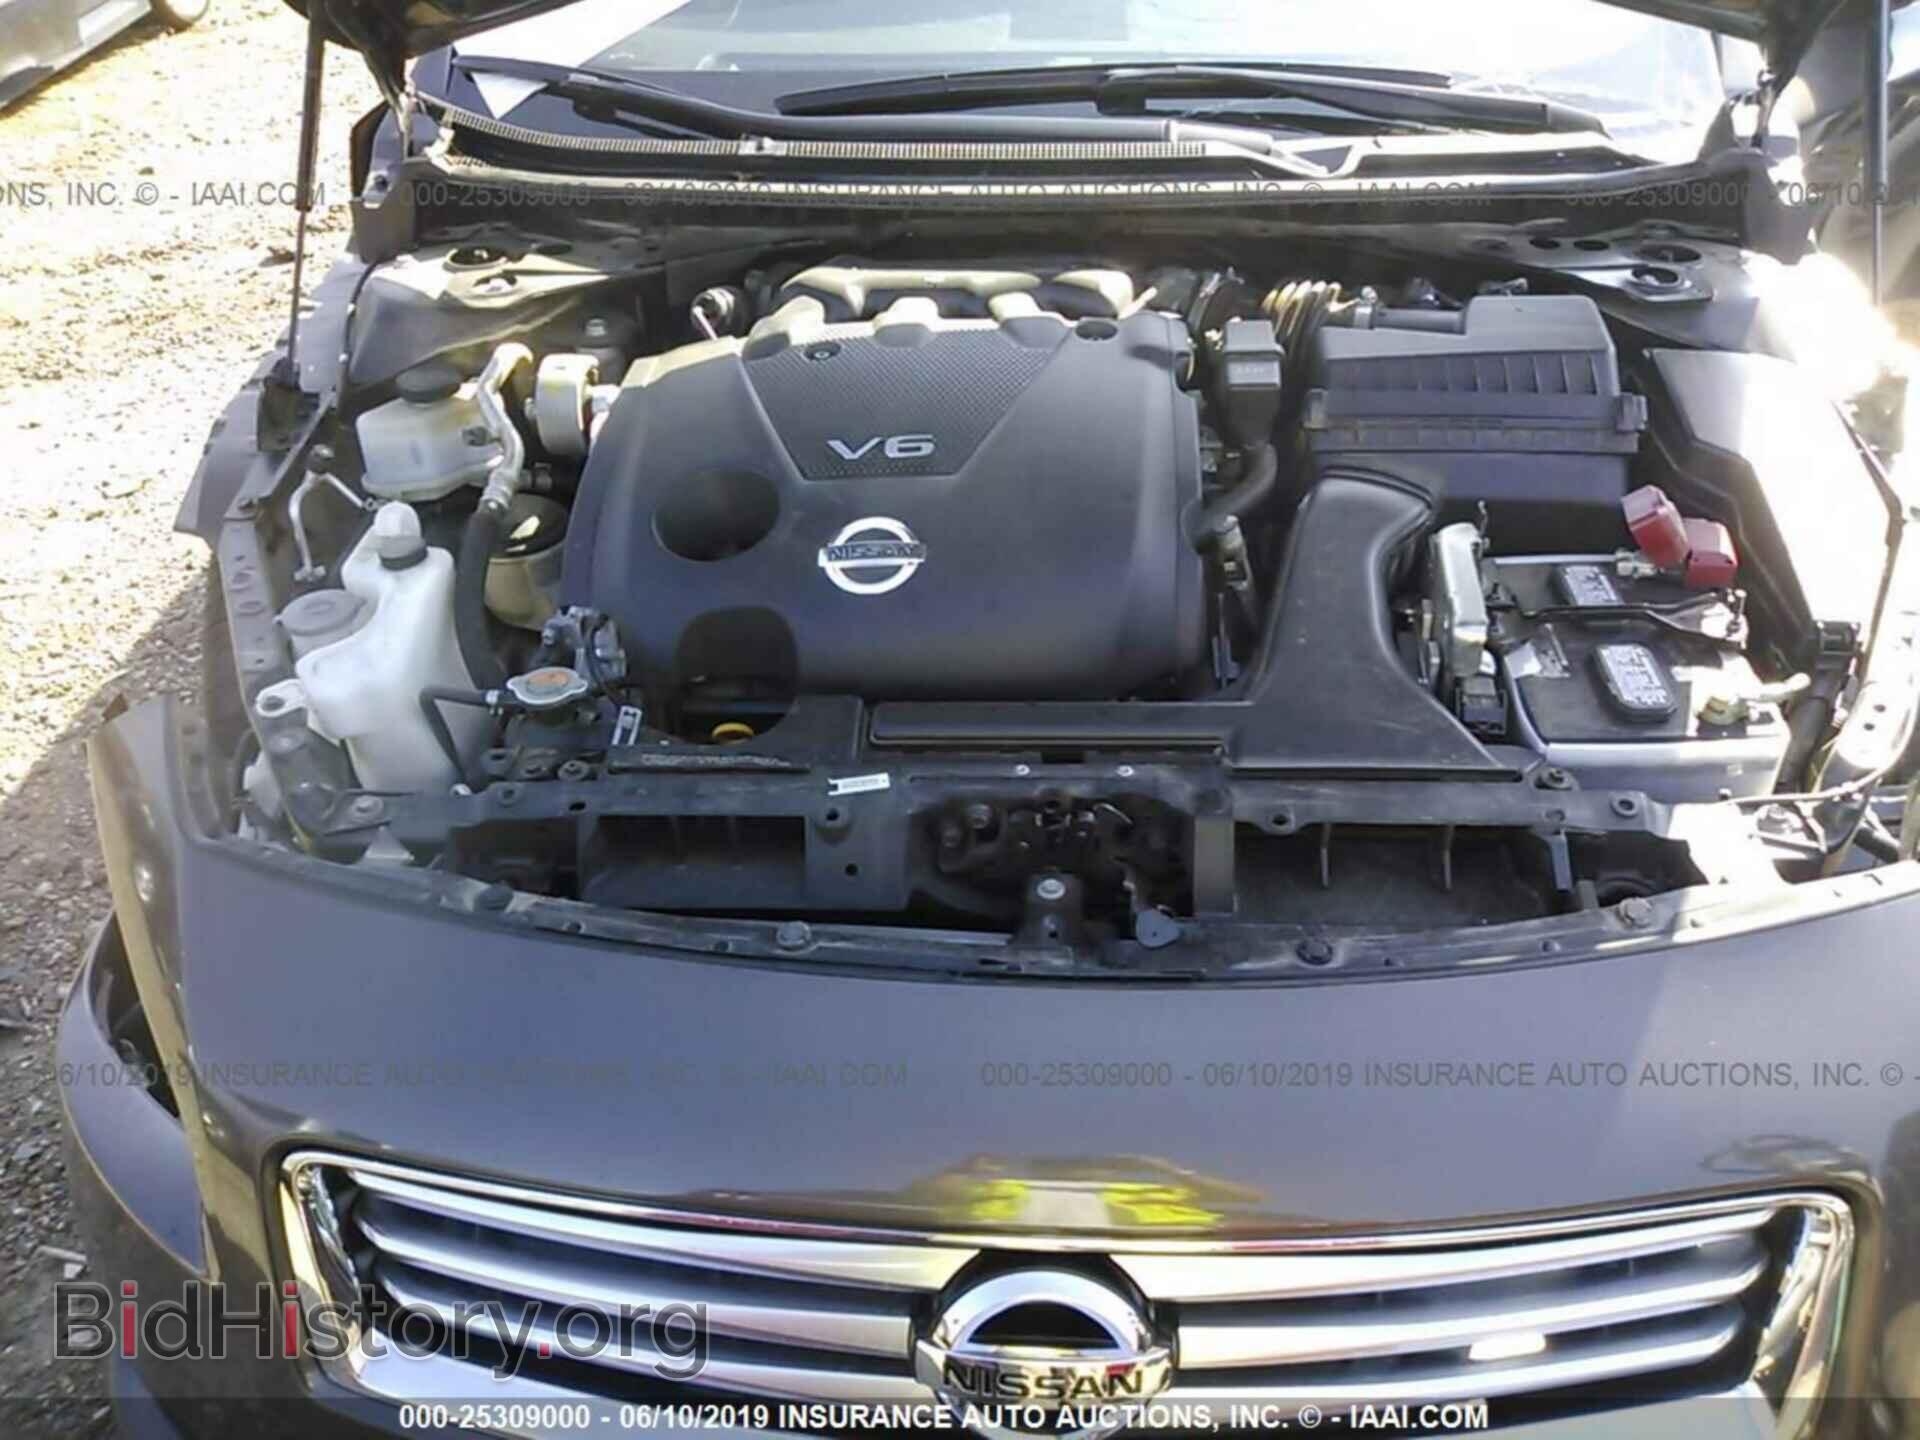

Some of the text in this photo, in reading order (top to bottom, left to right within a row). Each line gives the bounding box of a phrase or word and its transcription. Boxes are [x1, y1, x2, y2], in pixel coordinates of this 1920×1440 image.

[826, 433, 936, 460] V6
[829, 544, 916, 561] NISSAN
[943, 1354, 1144, 1400] NISSAN
